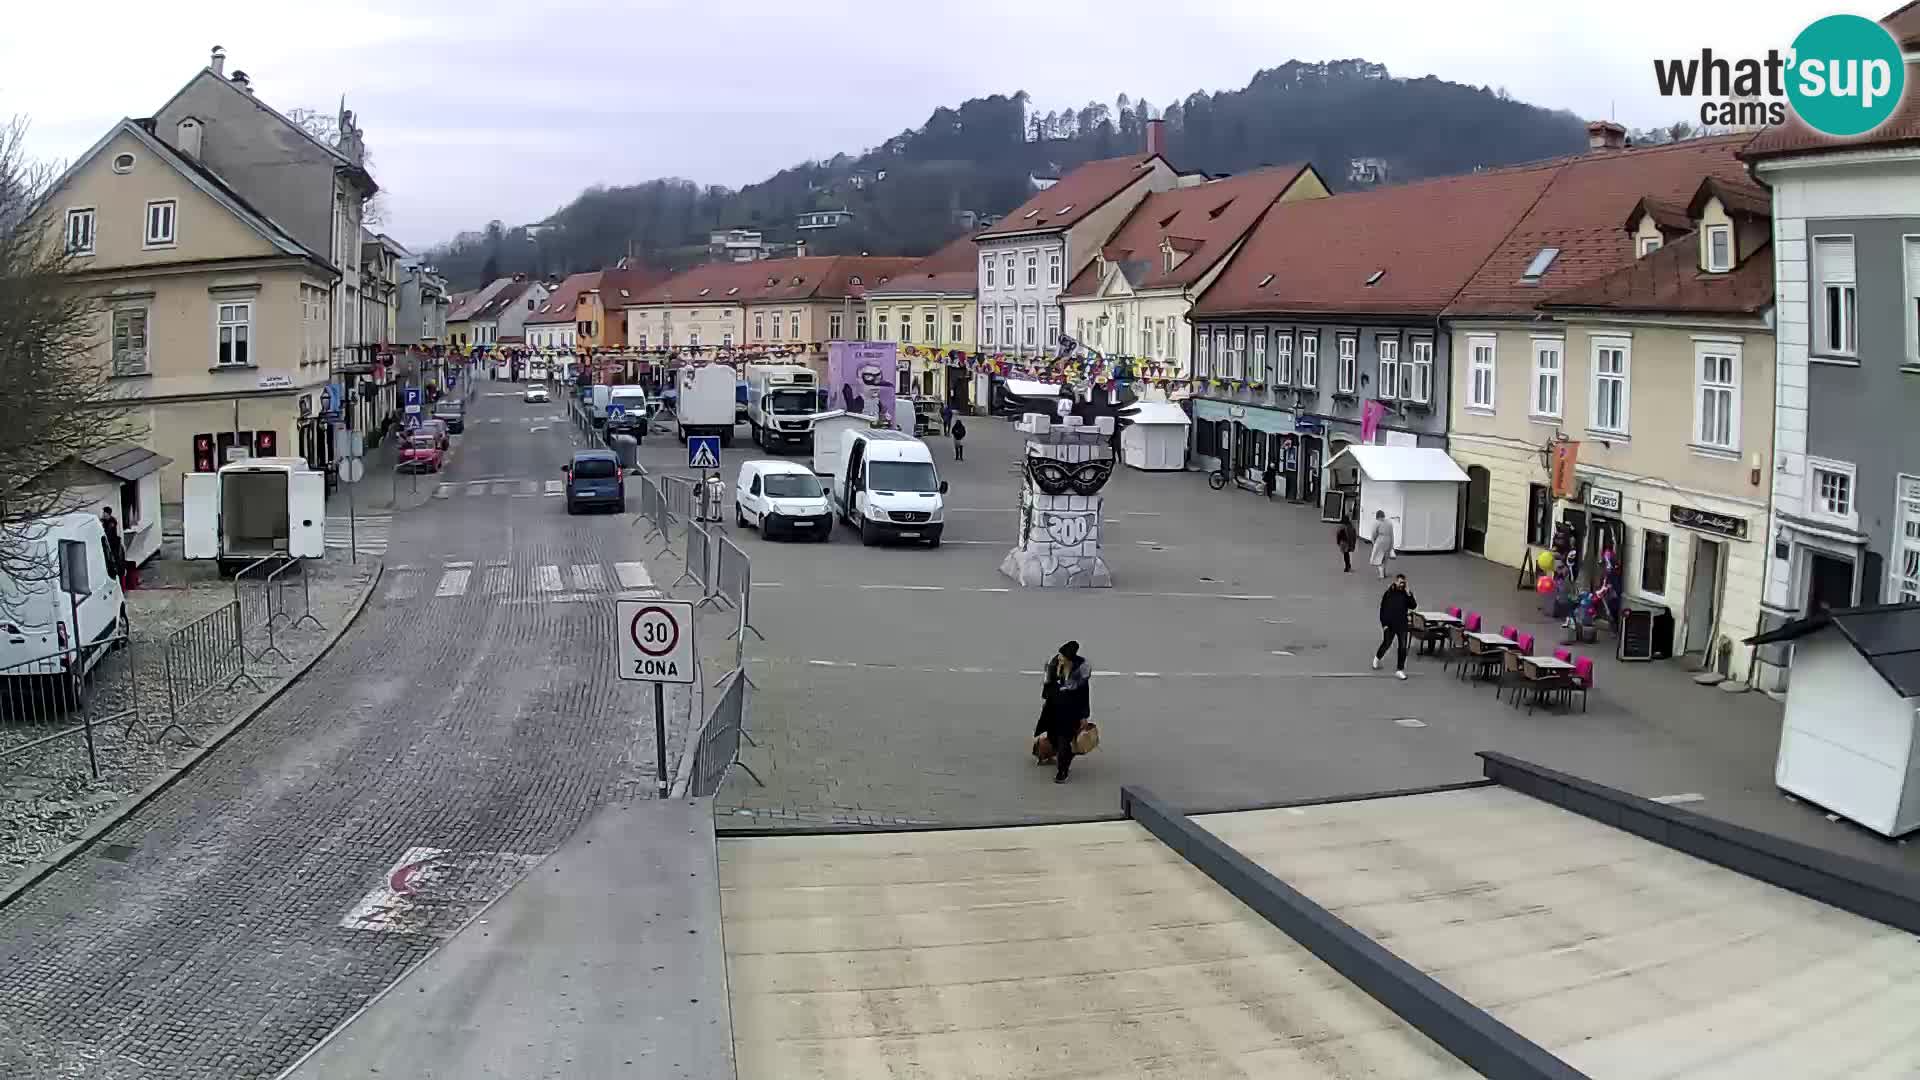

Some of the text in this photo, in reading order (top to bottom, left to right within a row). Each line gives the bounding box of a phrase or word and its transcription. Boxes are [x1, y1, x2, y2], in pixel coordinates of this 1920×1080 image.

[408, 392, 416, 402] P
[1047, 516, 1087, 546] 200
[643, 622, 668, 643] 30
[634, 659, 678, 676] ZONA
